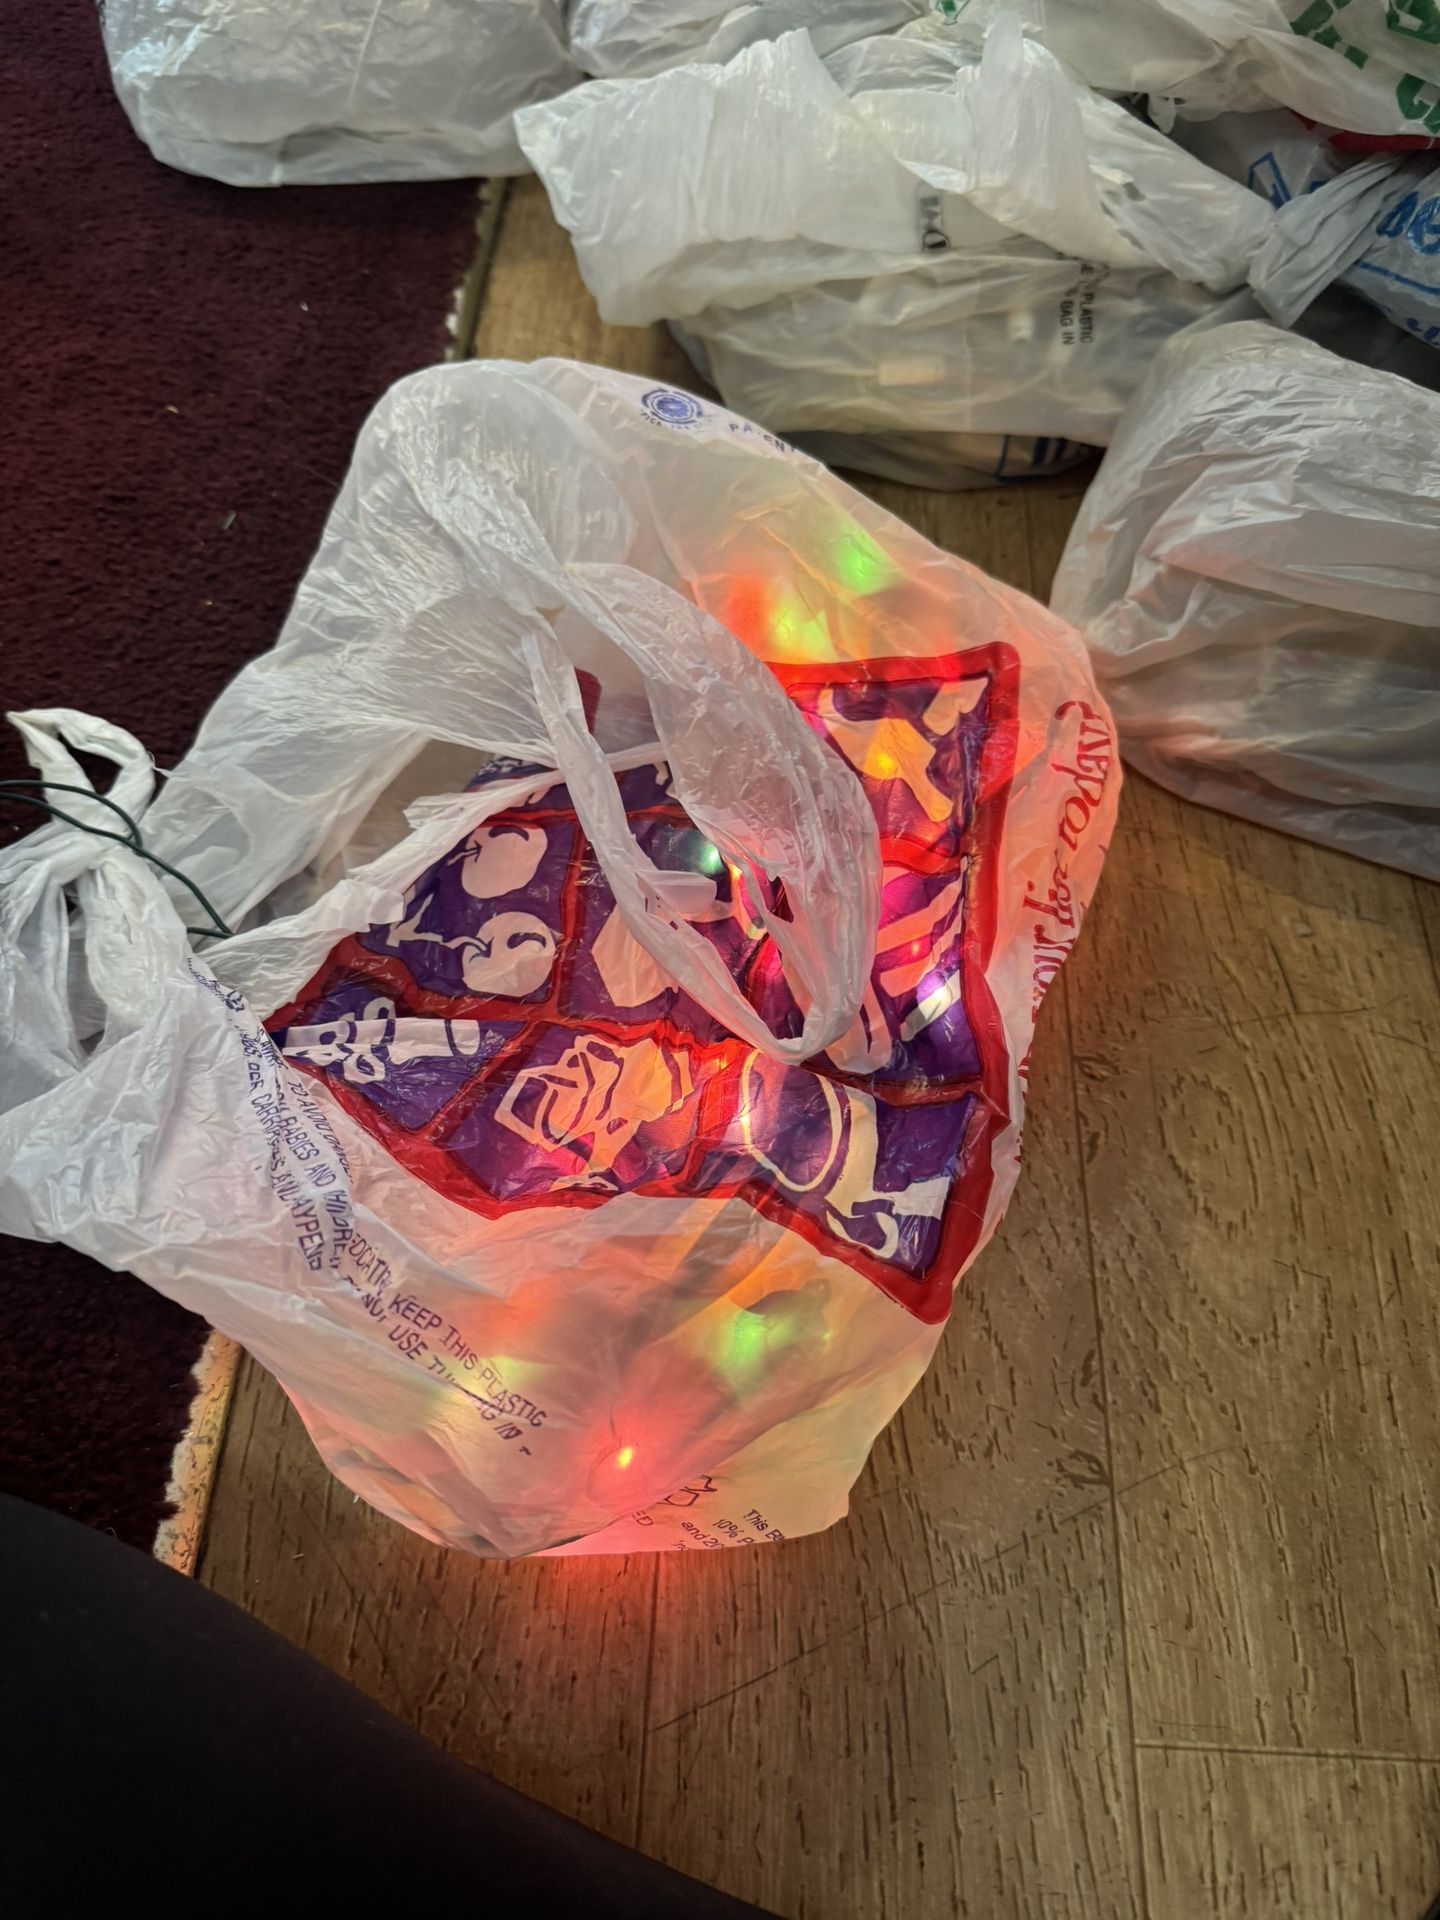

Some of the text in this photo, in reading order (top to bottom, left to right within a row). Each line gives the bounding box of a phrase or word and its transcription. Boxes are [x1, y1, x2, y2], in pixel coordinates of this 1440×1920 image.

[1060, 300, 1074, 345] BAG IN
[280, 1116, 320, 1161] BABIES
[304, 1163, 336, 1187] AND
[388, 1323, 428, 1361] USE
[388, 1294, 443, 1331] KEEP
[440, 1323, 478, 1370] THIS
[475, 1366, 548, 1428] PLASTIC
[681, 1519, 708, 1543] and
[712, 1518, 739, 1539] 10%
[743, 1508, 768, 1533] This
